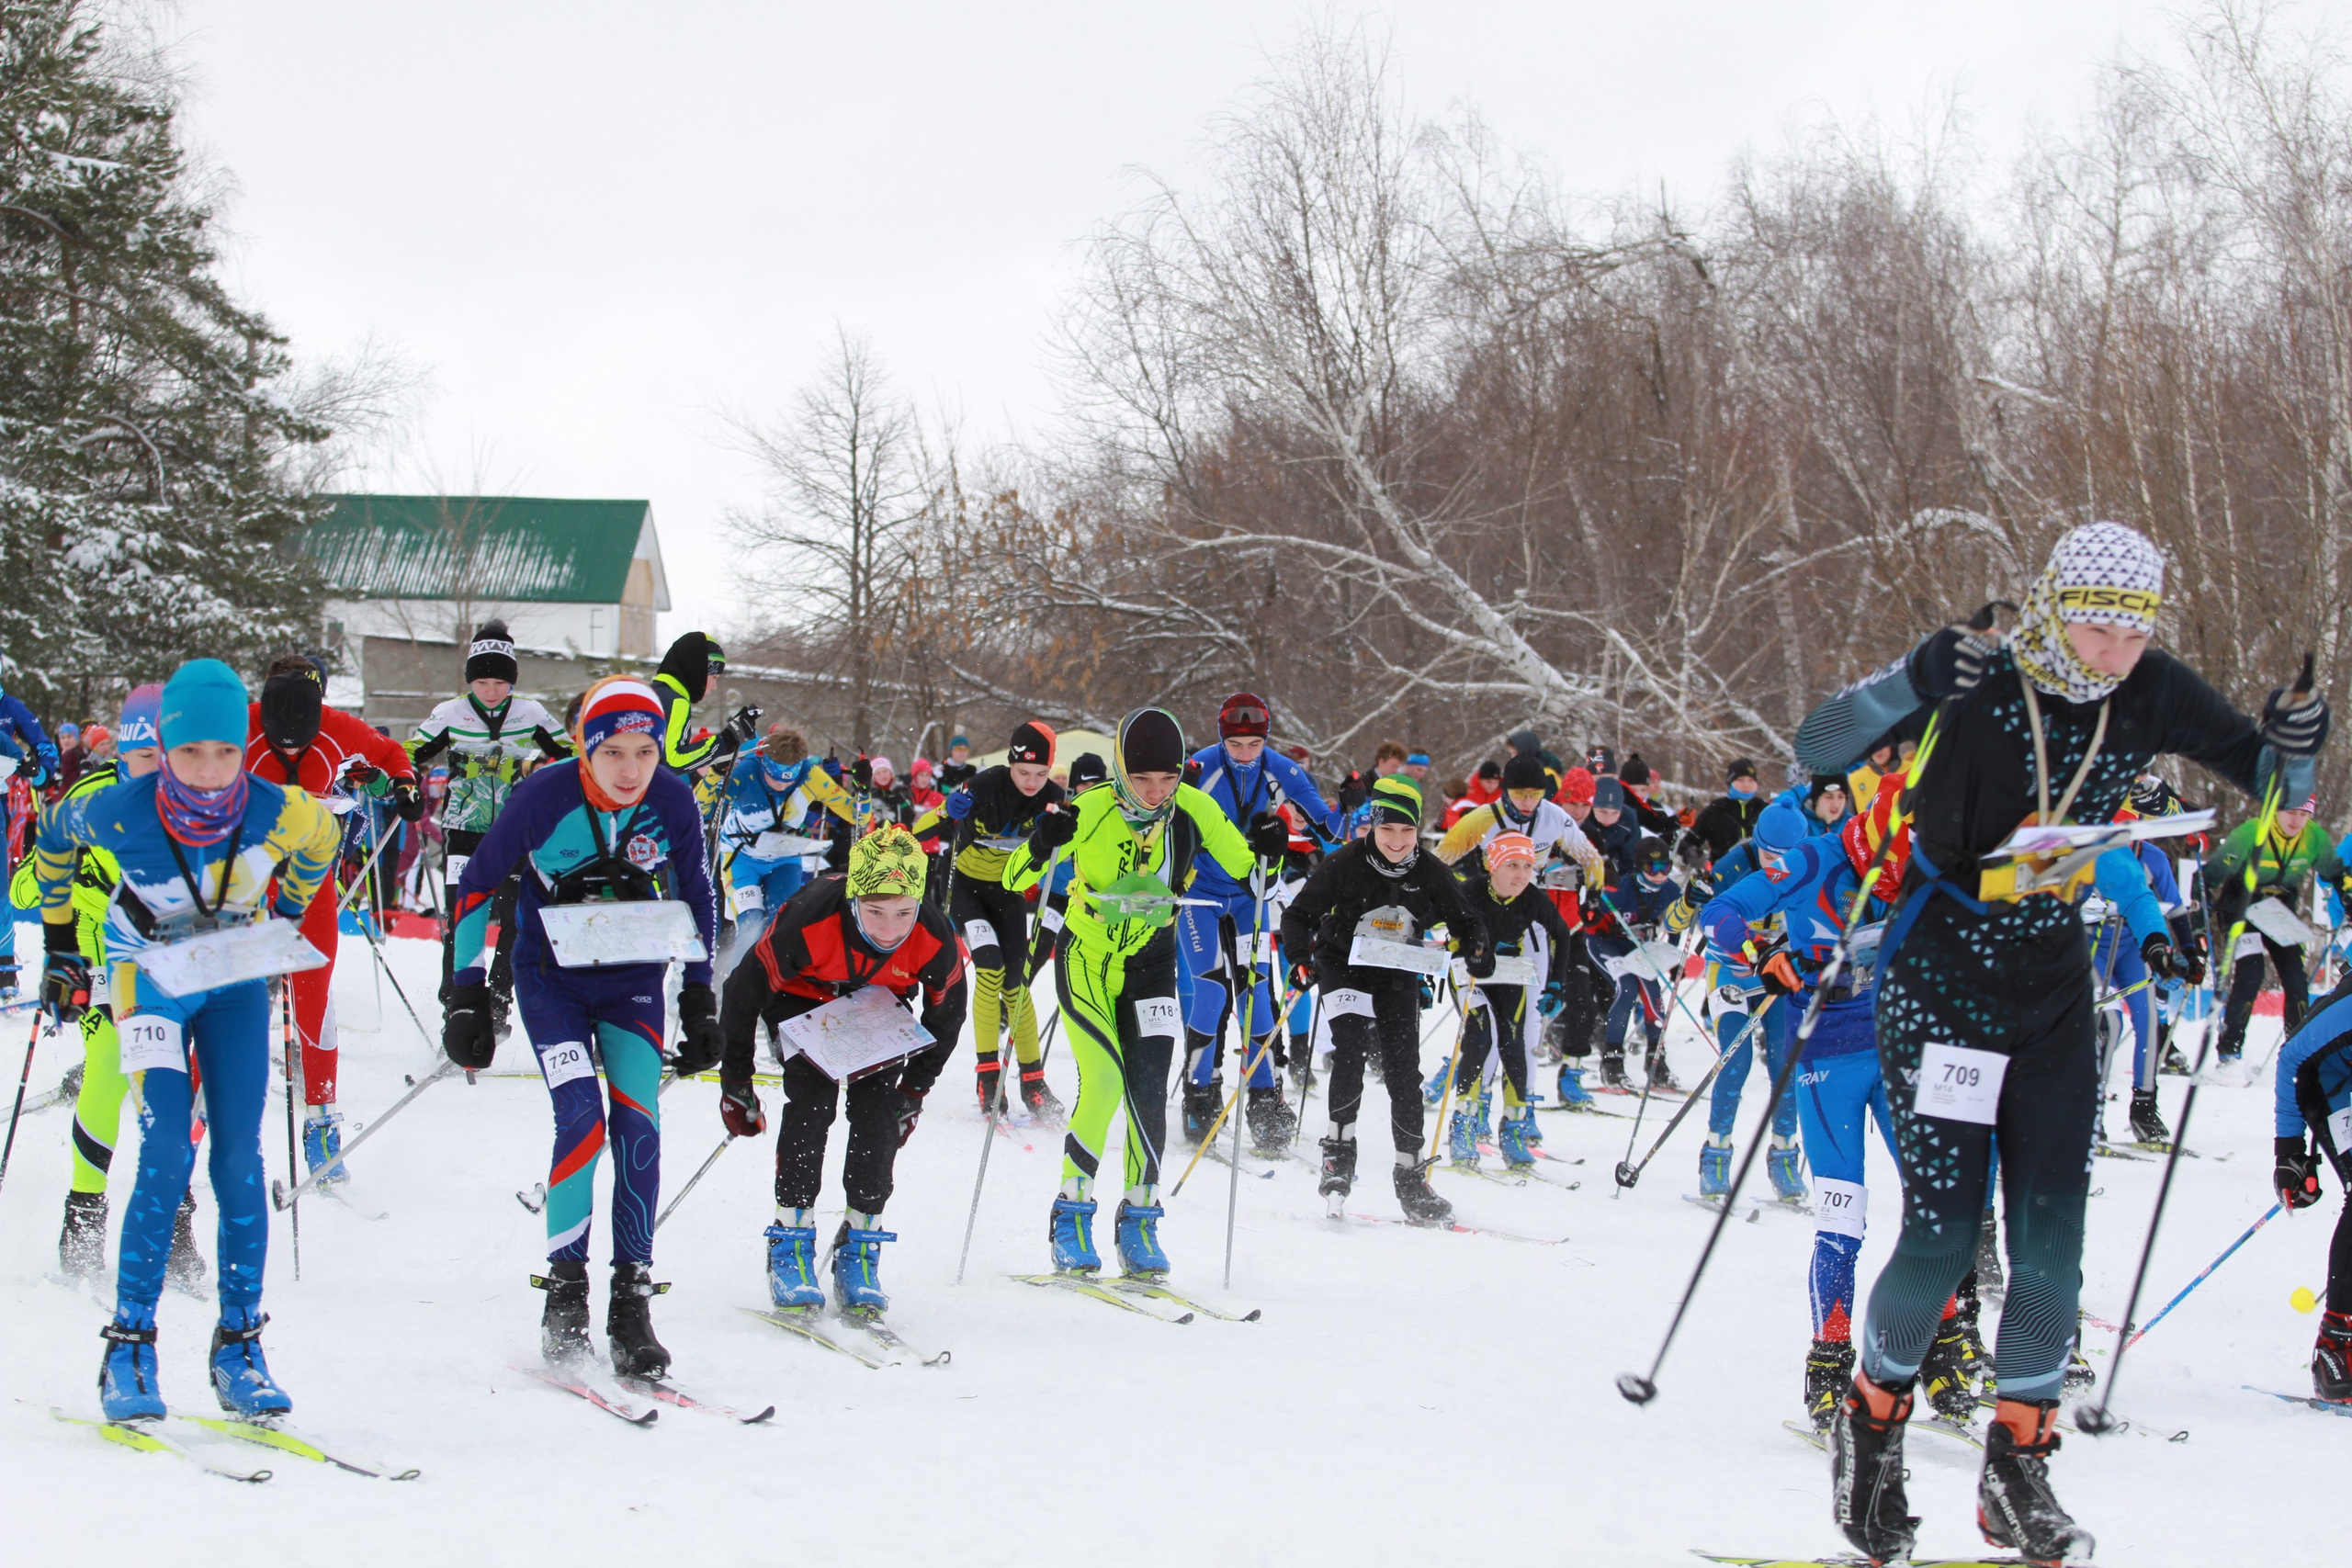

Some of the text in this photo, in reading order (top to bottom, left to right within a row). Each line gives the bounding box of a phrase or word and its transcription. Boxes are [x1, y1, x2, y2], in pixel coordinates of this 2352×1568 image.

[117, 716, 157, 740] wix
[740, 889, 755, 899] 758
[975, 925, 991, 933] 737
[1244, 940, 1263, 950] 77
[1337, 994, 1357, 1002] 727
[1149, 1005, 1174, 1017] 718
[133, 1025, 165, 1043] 710
[548, 1049, 580, 1069] 720
[1798, 1069, 1830, 1087] RAY
[1943, 1064, 1980, 1087] 709
[1824, 1190, 1853, 1208] 707
[107, 1329, 141, 1341] SPINE
[1937, 1332, 1964, 1345] FISCHER
